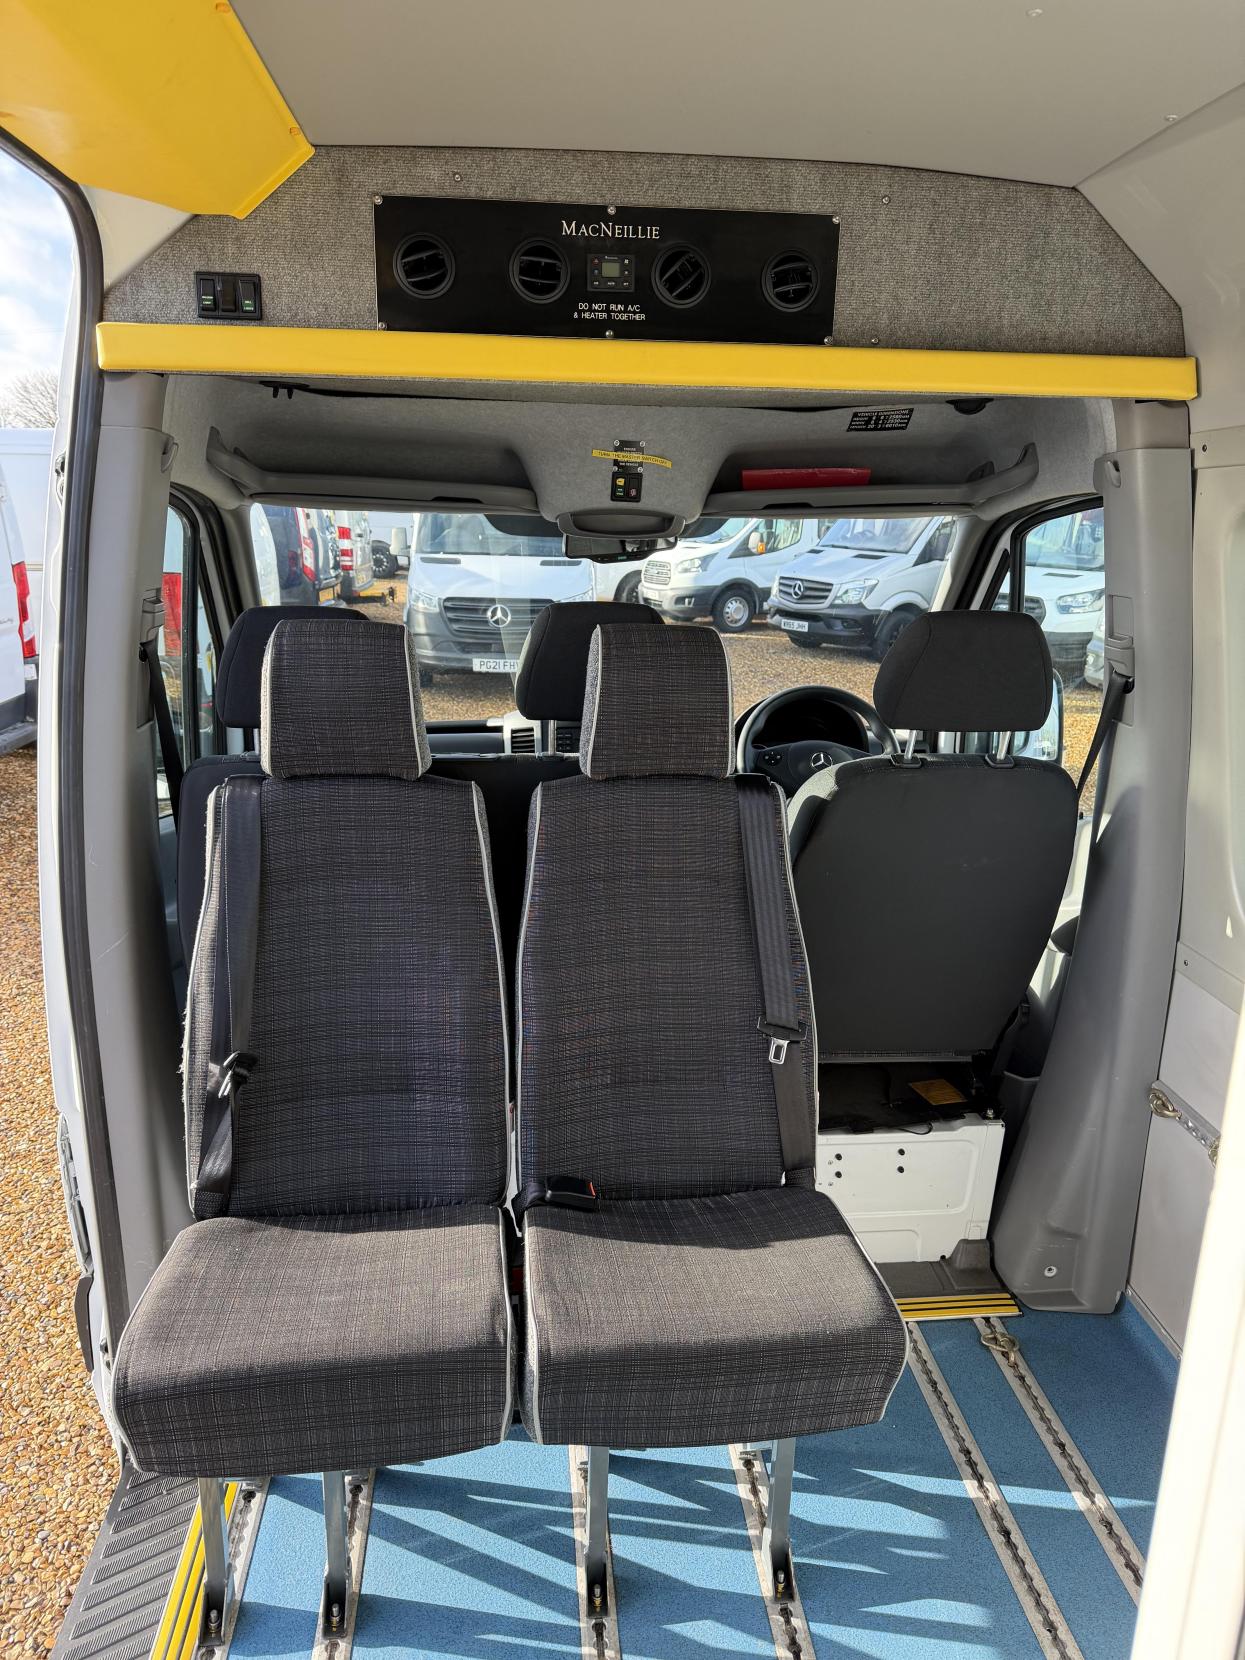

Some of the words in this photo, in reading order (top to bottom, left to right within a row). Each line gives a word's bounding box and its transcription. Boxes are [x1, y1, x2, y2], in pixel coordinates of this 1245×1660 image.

[592, 303, 607, 311] NOT
[627, 304, 640, 312] A/C
[479, 660, 500, 670] PG21
